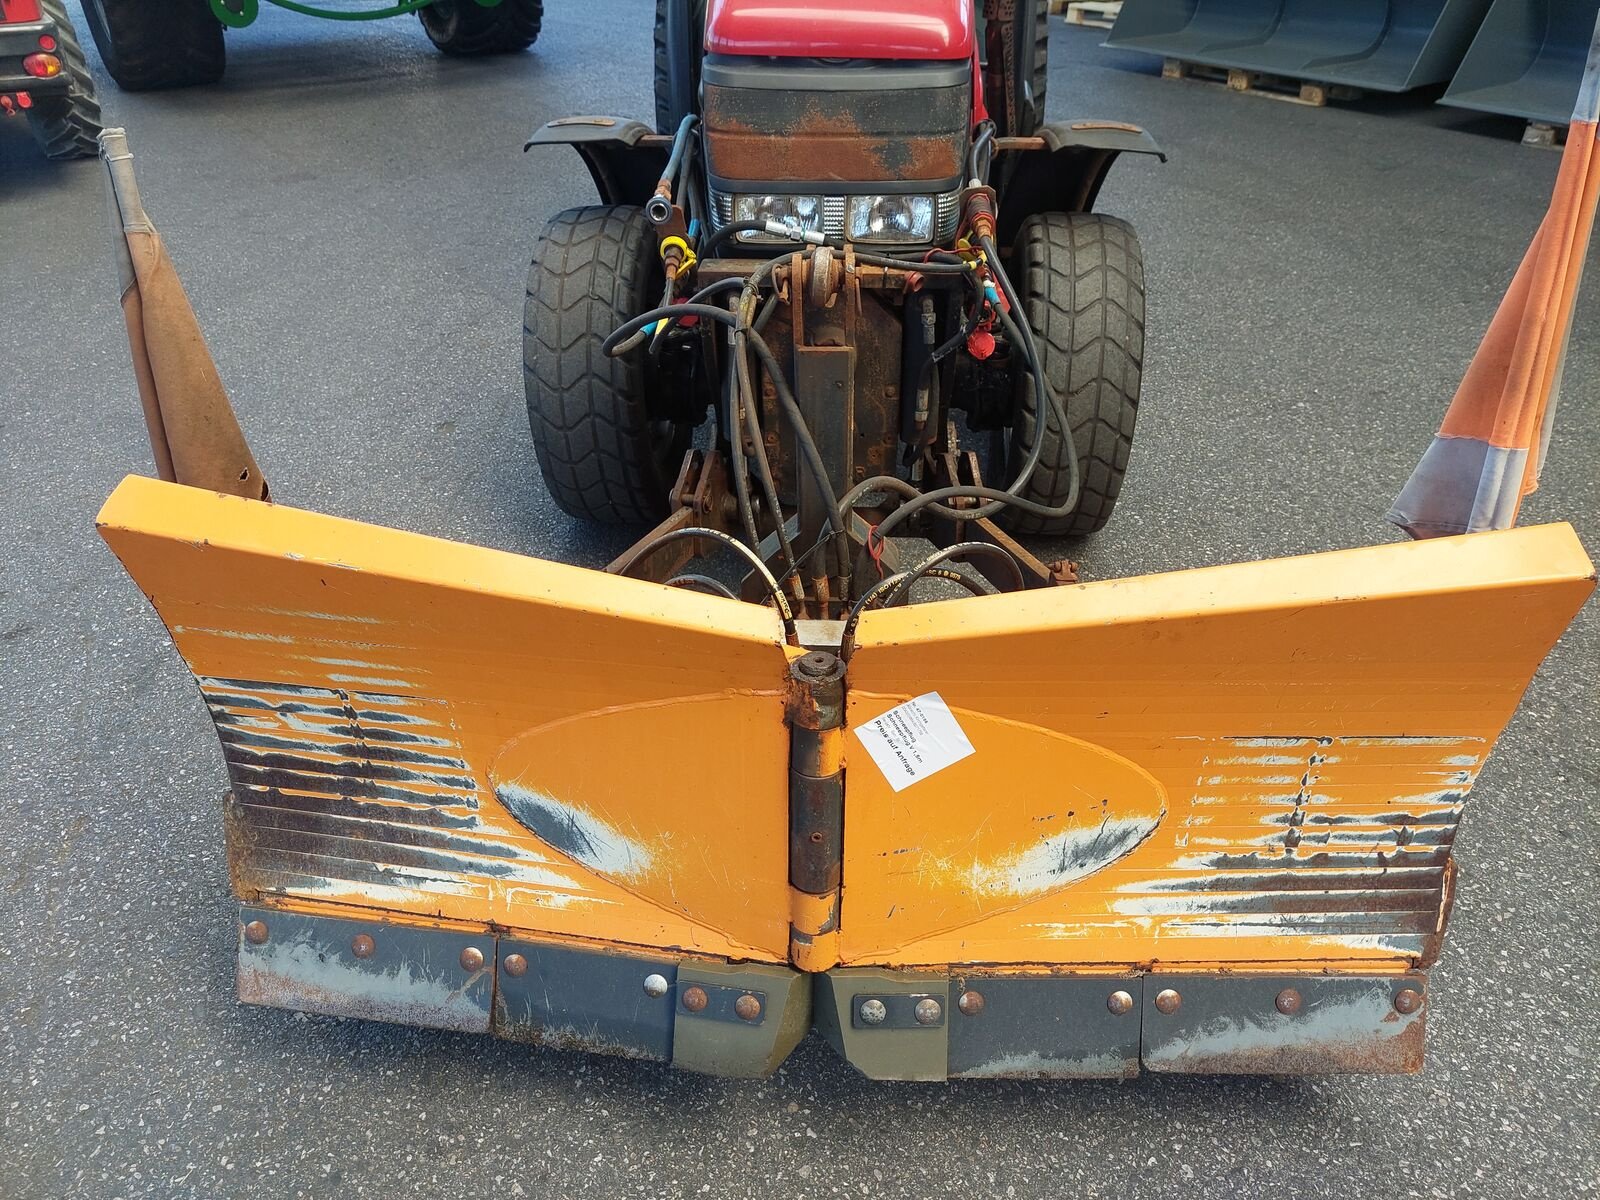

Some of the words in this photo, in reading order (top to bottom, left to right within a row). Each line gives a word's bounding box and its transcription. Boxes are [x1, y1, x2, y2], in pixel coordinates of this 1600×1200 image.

[887, 713, 911, 747] Schneepflug
[893, 710, 917, 743] Schneepflug
[874, 720, 889, 738] Preis
[887, 738, 898, 750] auf
[896, 751, 915, 776] Anfrage
